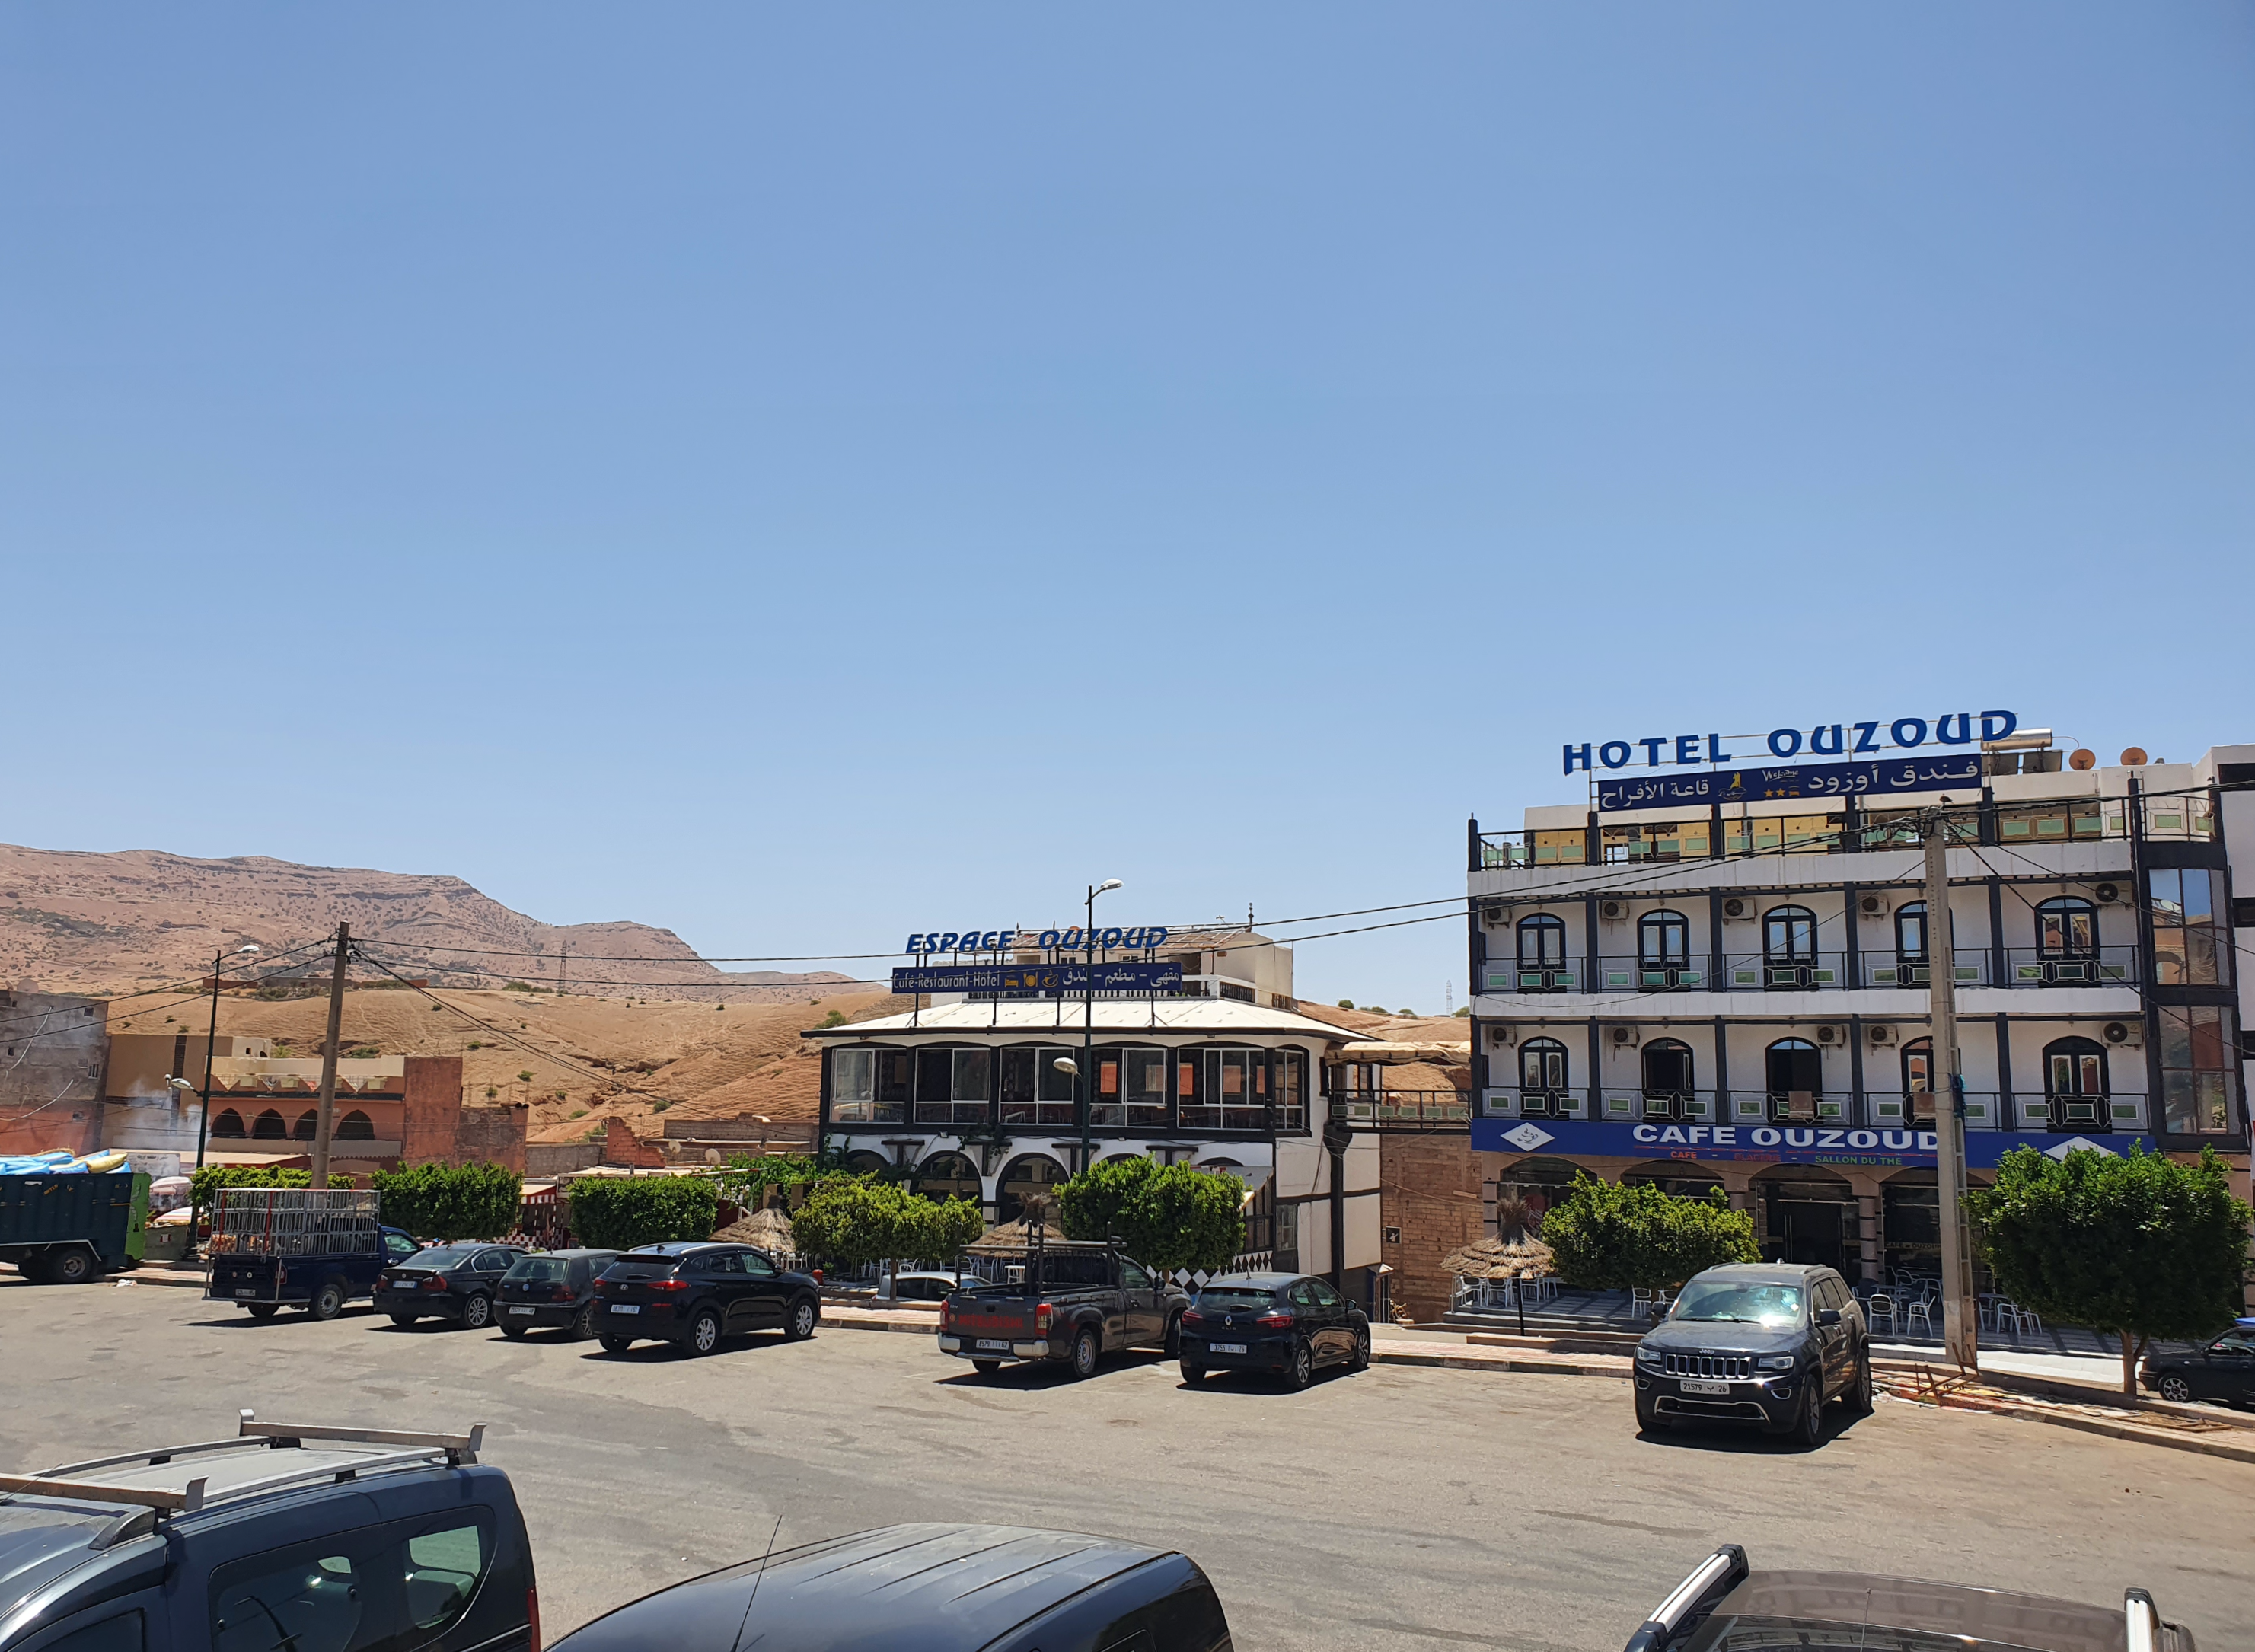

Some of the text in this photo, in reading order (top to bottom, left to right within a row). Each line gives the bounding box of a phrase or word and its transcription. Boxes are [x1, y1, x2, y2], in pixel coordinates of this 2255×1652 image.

[1563, 710, 2018, 776] HOTEL OUZOUD
[1762, 770, 1798, 782] Welcome
[1808, 761, 1978, 793] فندق أوزود
[1601, 779, 1709, 808] قاعة الأفراح
[906, 927, 1168, 953] ESPACE OUZOUD
[1063, 968, 1089, 985] ندق
[1105, 968, 1136, 987] مطعم
[1632, 1124, 1938, 1150] CAFE OUZOUD
[1670, 1150, 1698, 1159] CAFE
[1815, 1155, 1858, 1164] SALLON
[1880, 1157, 1902, 1166] THE
[1718, 1384, 1727, 1392] 26
